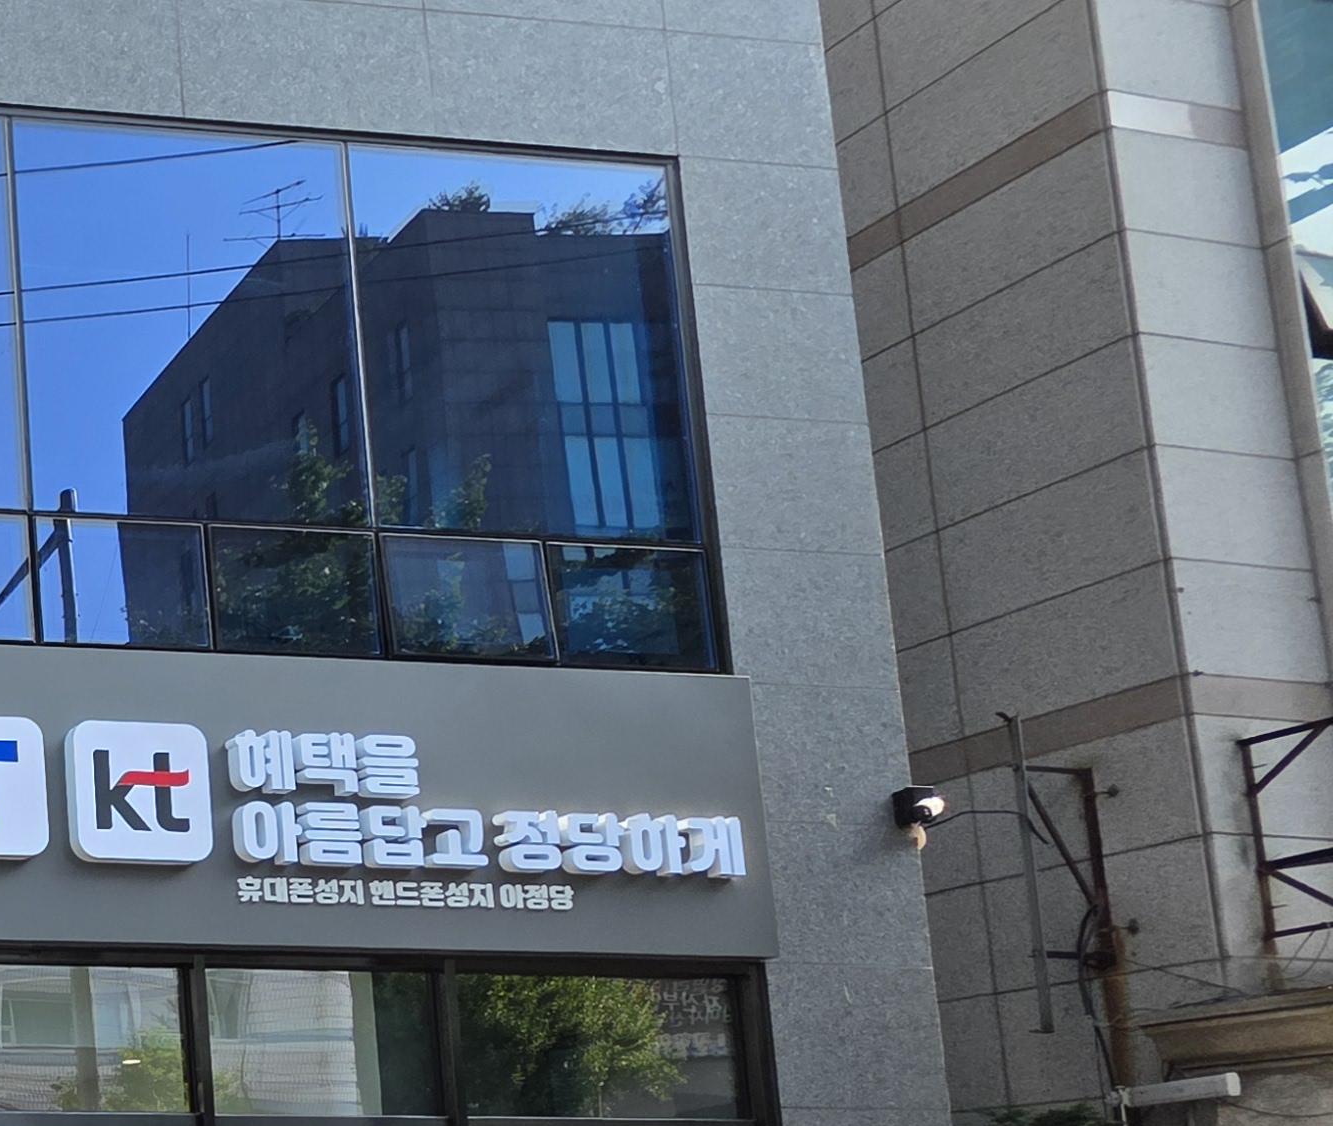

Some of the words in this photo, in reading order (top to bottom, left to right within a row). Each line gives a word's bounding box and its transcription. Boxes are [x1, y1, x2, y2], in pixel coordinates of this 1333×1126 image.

[92, 748, 191, 833] kt
[225, 729, 421, 799] 혜택을
[233, 799, 490, 869] 아름답고
[492, 808, 747, 879] 정당하게
[236, 875, 365, 906] 휴대폰성지
[368, 880, 496, 909] 핸드폰성지
[499, 883, 576, 911] 아정당
